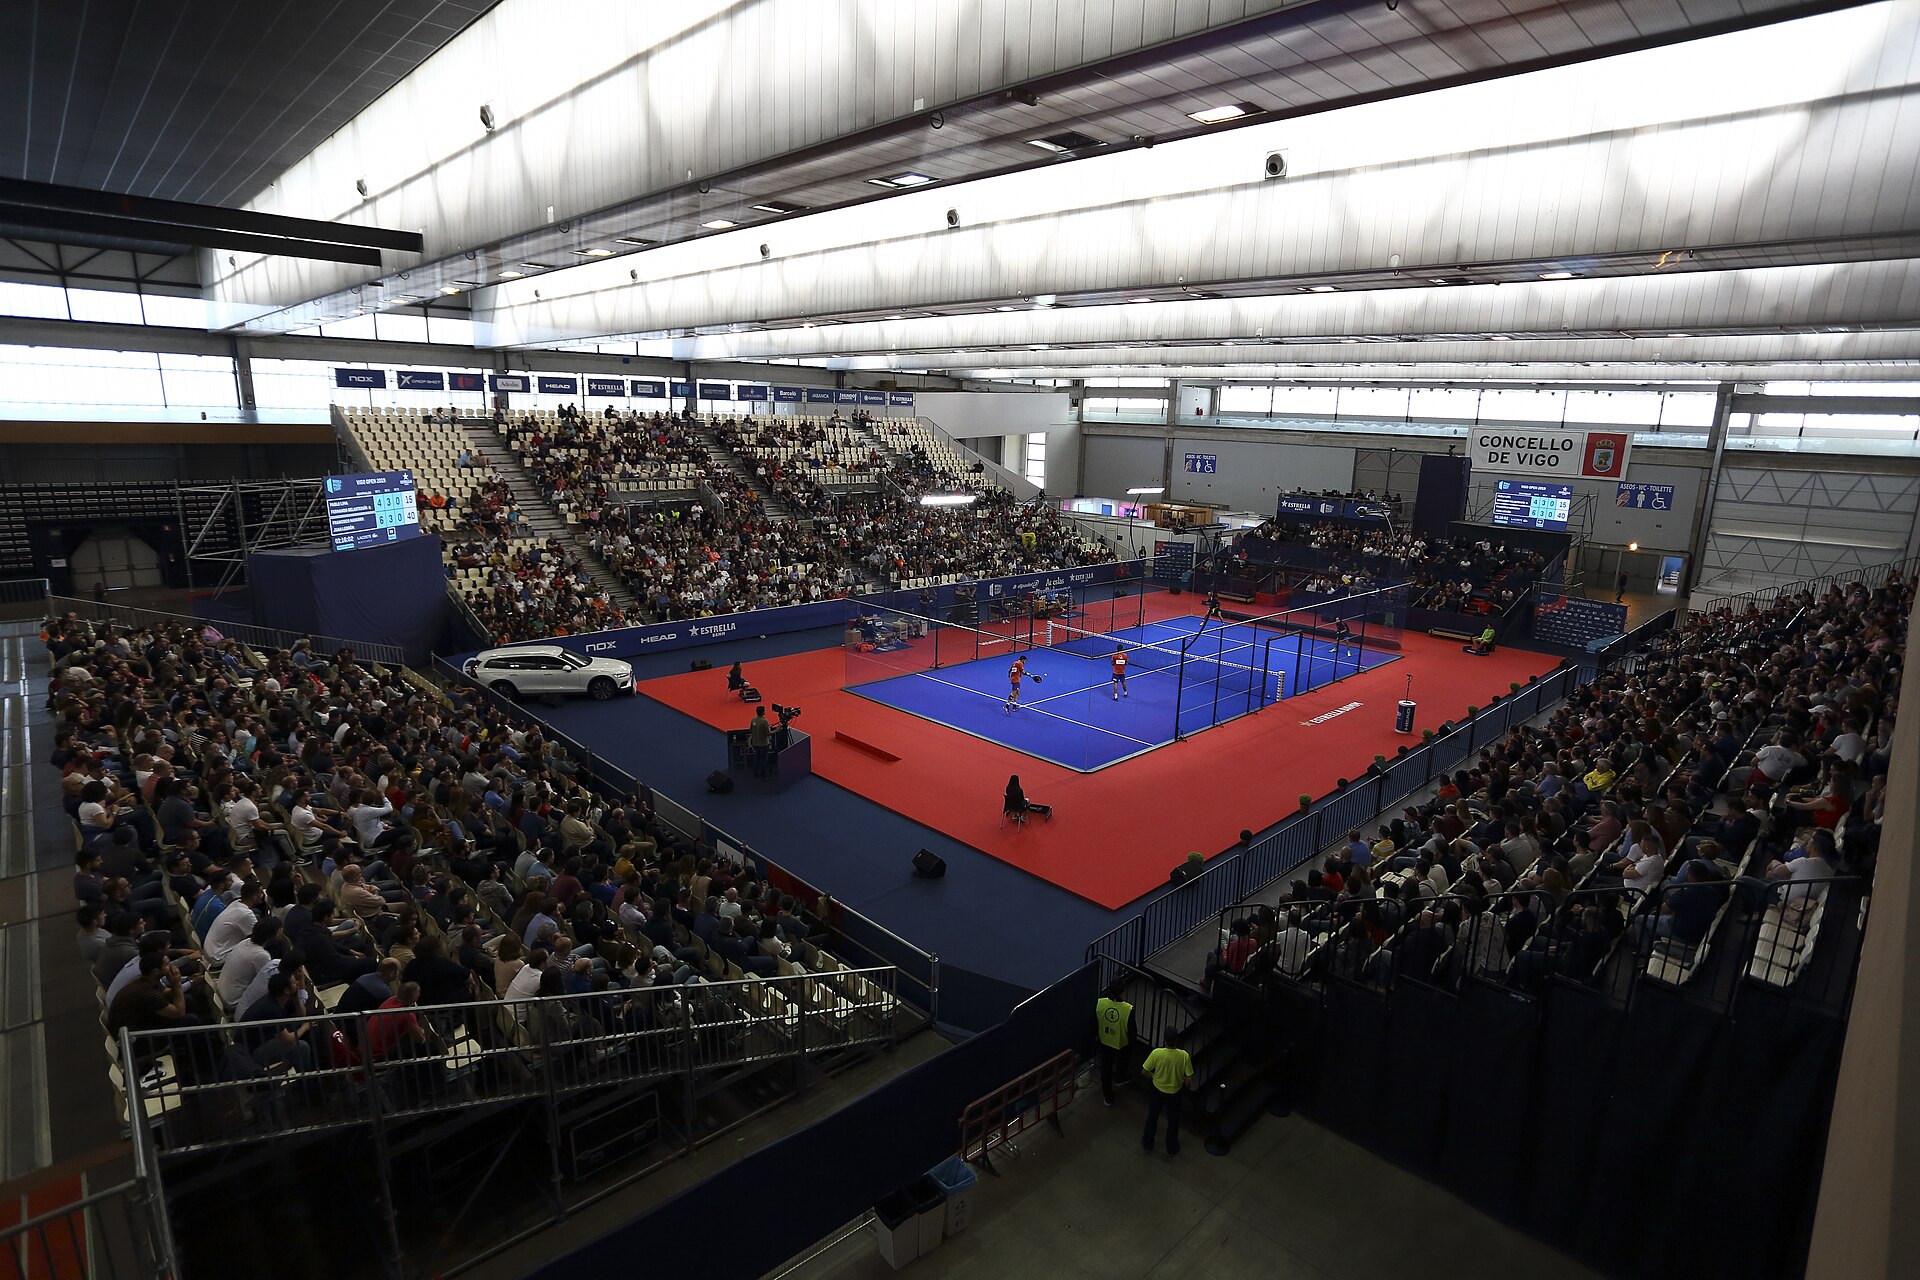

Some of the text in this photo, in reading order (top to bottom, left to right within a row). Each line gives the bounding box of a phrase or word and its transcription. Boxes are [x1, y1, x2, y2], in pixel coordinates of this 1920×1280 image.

[1479, 435, 1574, 451] CONCELLO
[1488, 451, 1560, 467] DE VIGO
[1650, 485, 1672, 493] TOILETTE
[405, 495, 413, 504] 15
[407, 512, 415, 520] 40
[700, 623, 736, 635] ESTRELLA
[640, 633, 677, 644] HEAD
